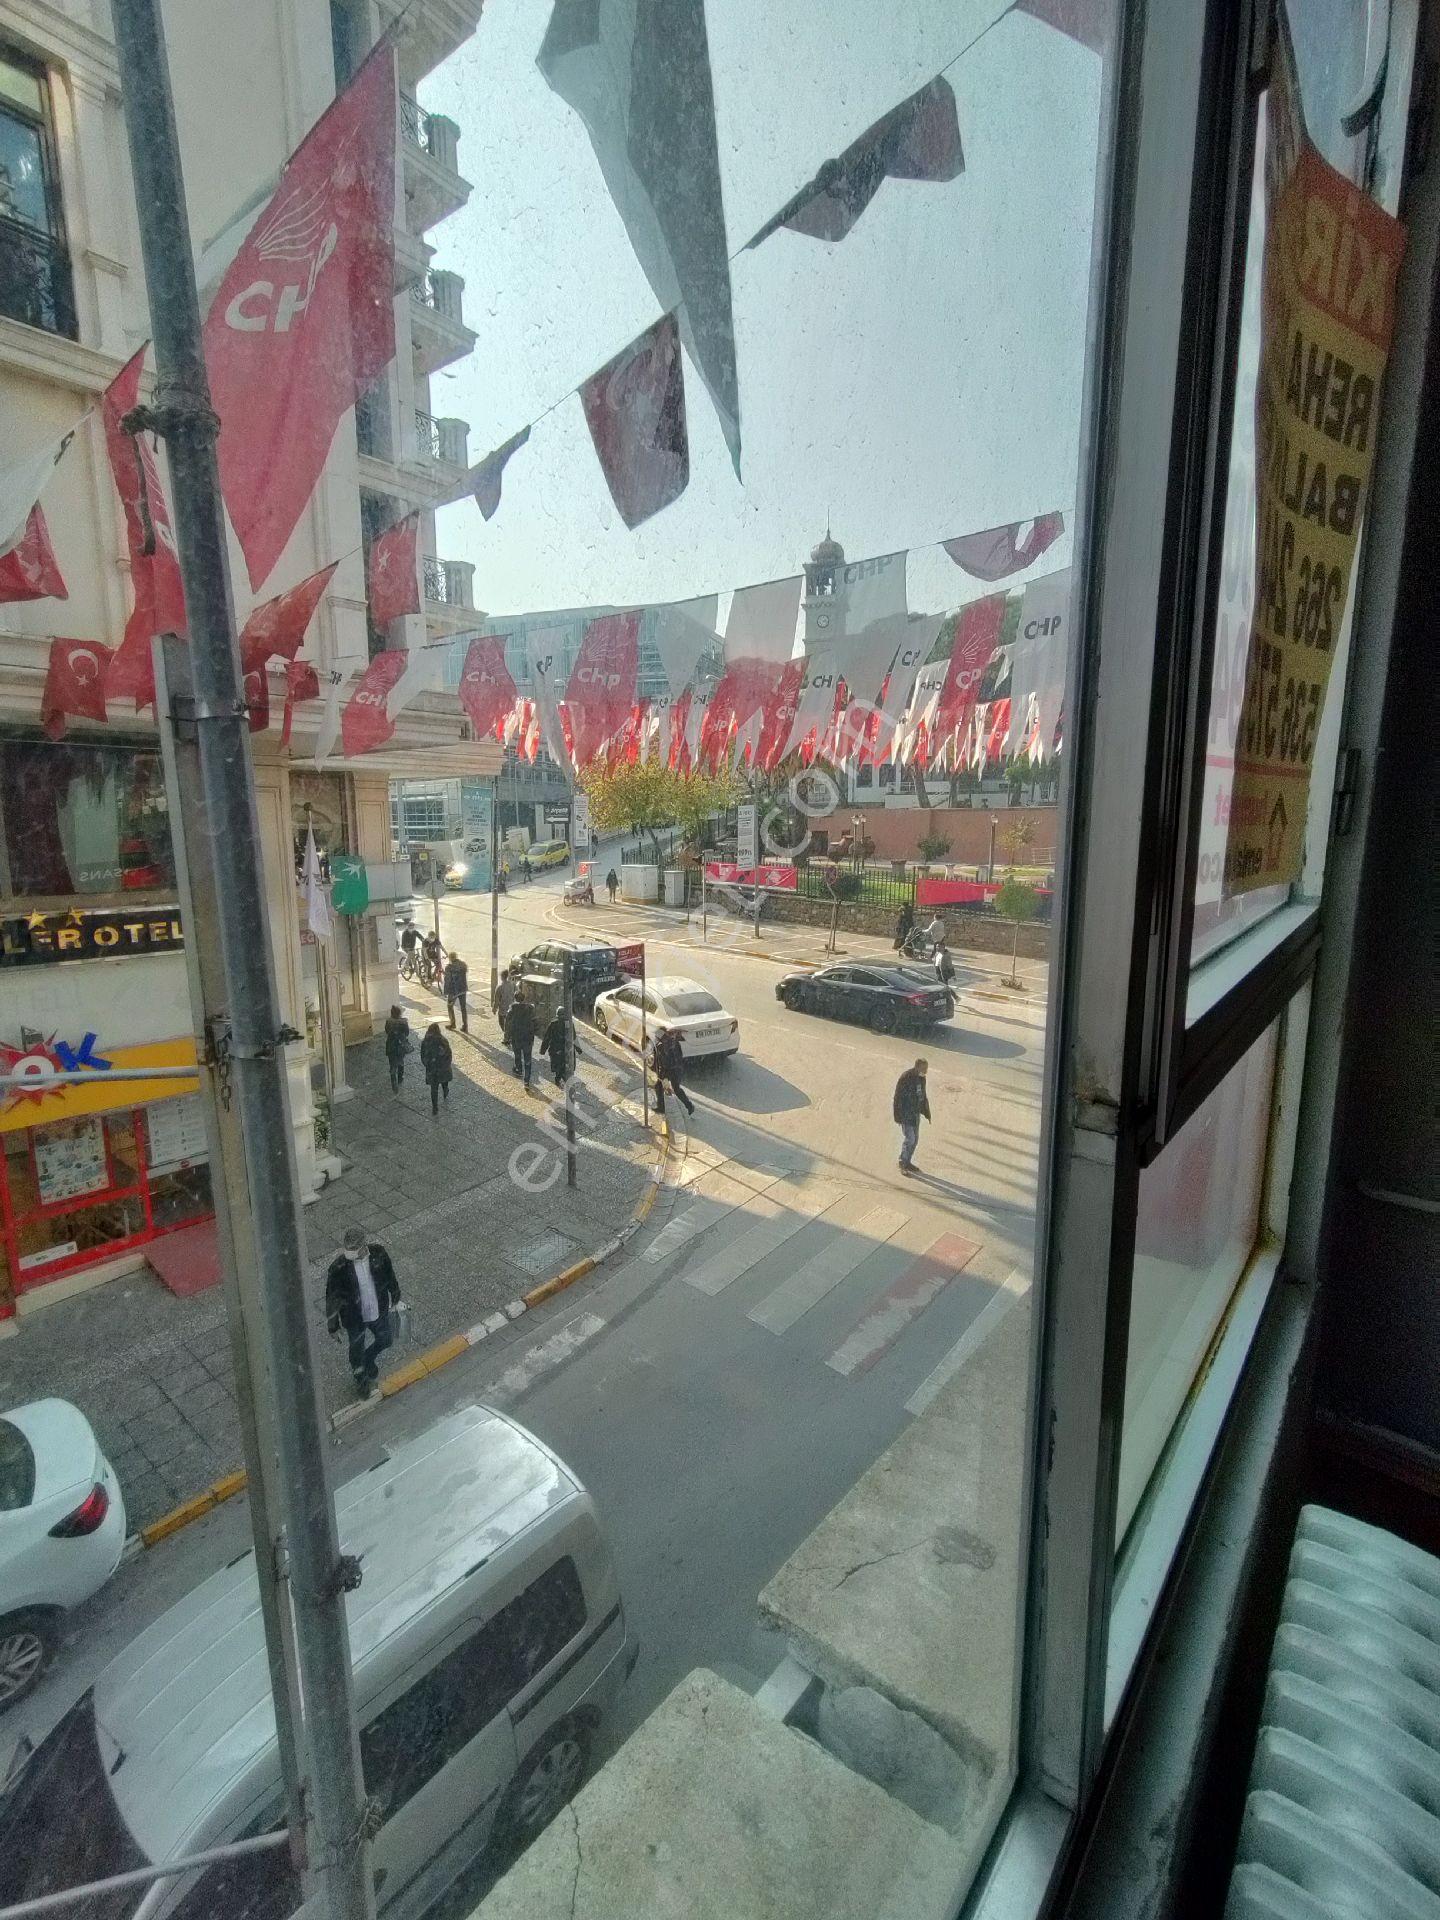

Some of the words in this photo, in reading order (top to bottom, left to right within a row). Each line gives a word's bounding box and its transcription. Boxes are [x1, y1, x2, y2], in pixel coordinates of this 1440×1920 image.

[224, 280, 308, 333] CH
[844, 556, 893, 585] CHP
[1024, 615, 1062, 640] CHP
[536, 655, 553, 676] CP
[466, 671, 499, 688] CH
[577, 667, 621, 691] CHP
[812, 674, 833, 689] CH
[956, 668, 982, 690] CP
[93, 921, 183, 946] OTEL
